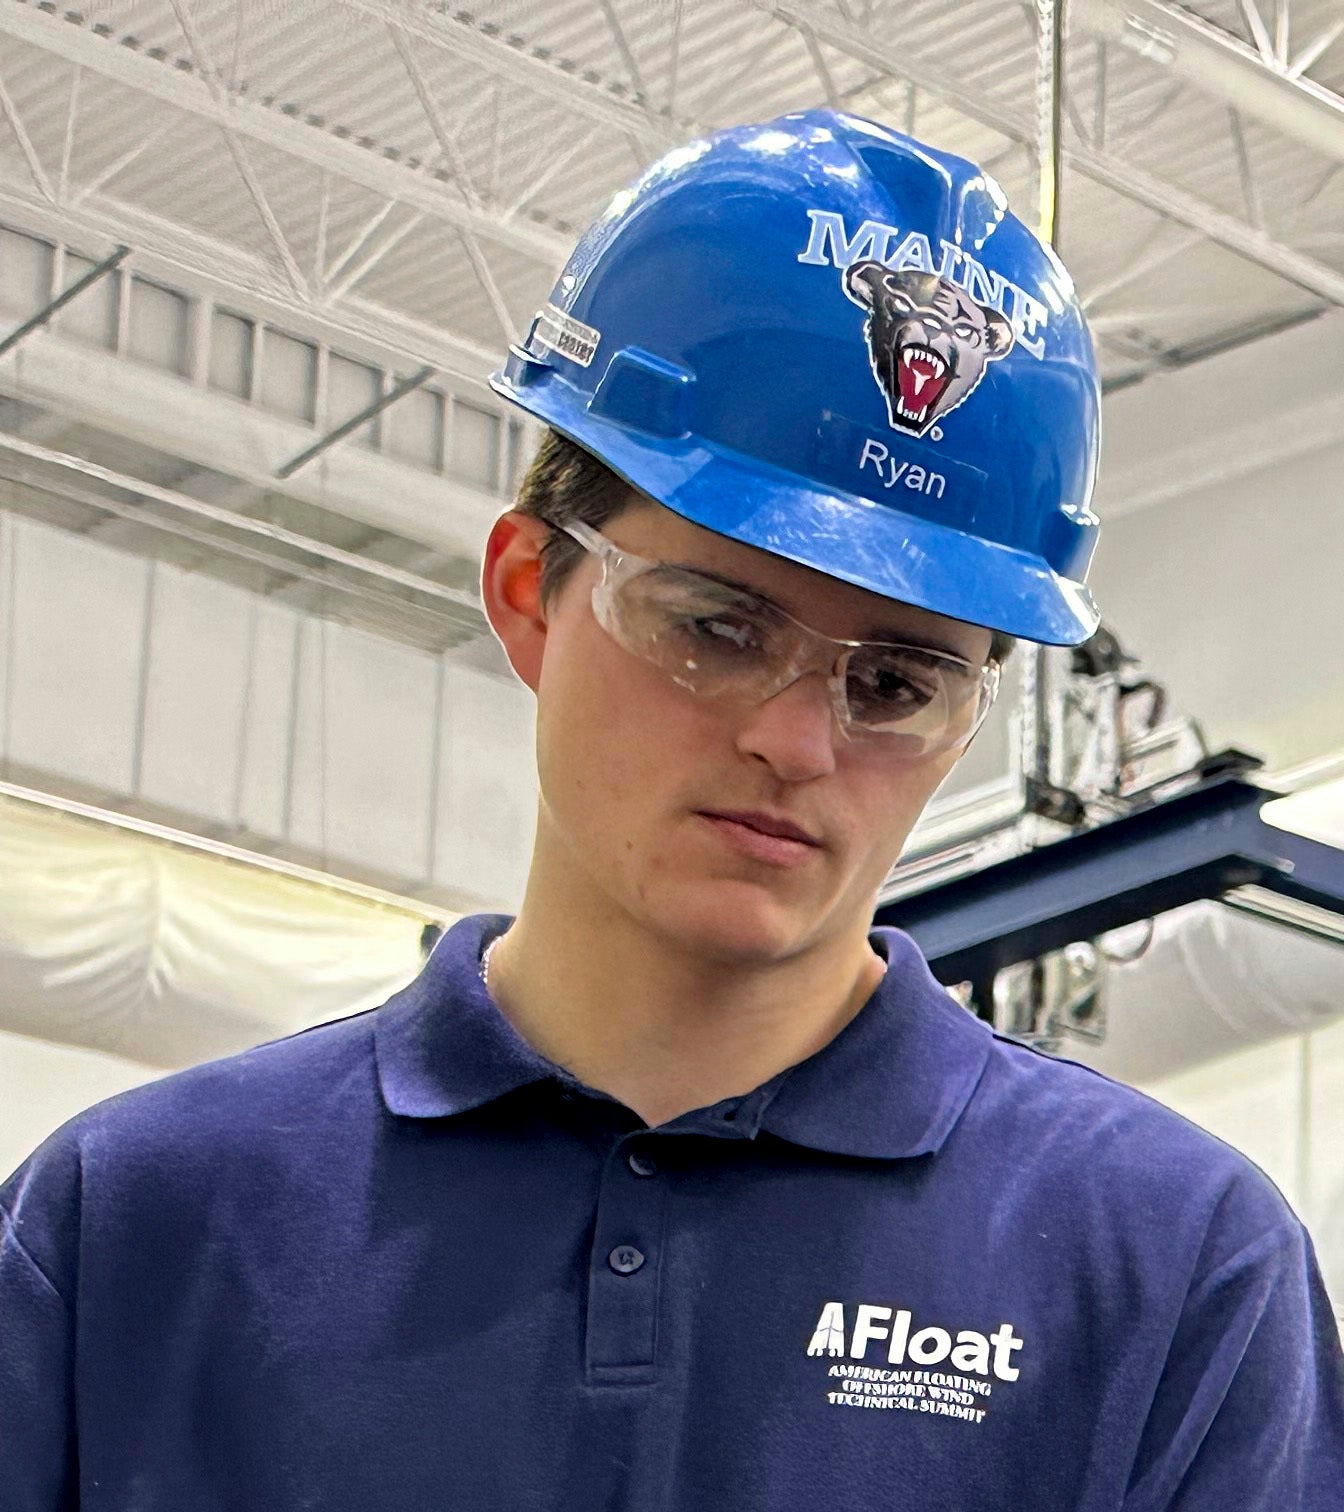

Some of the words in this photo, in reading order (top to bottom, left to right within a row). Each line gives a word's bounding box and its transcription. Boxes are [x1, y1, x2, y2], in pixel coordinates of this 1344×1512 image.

[798, 209, 1048, 361] MAINE
[859, 438, 946, 499] Ryan
[828, 1364, 912, 1383] AMERICAN
[913, 1370, 992, 1397] FLOATING
[842, 1379, 926, 1398] OFFSHORE
[927, 1385, 975, 1406] WIND
[827, 1392, 918, 1411] TECHNICAL
[918, 1400, 986, 1424] SUMMIT
